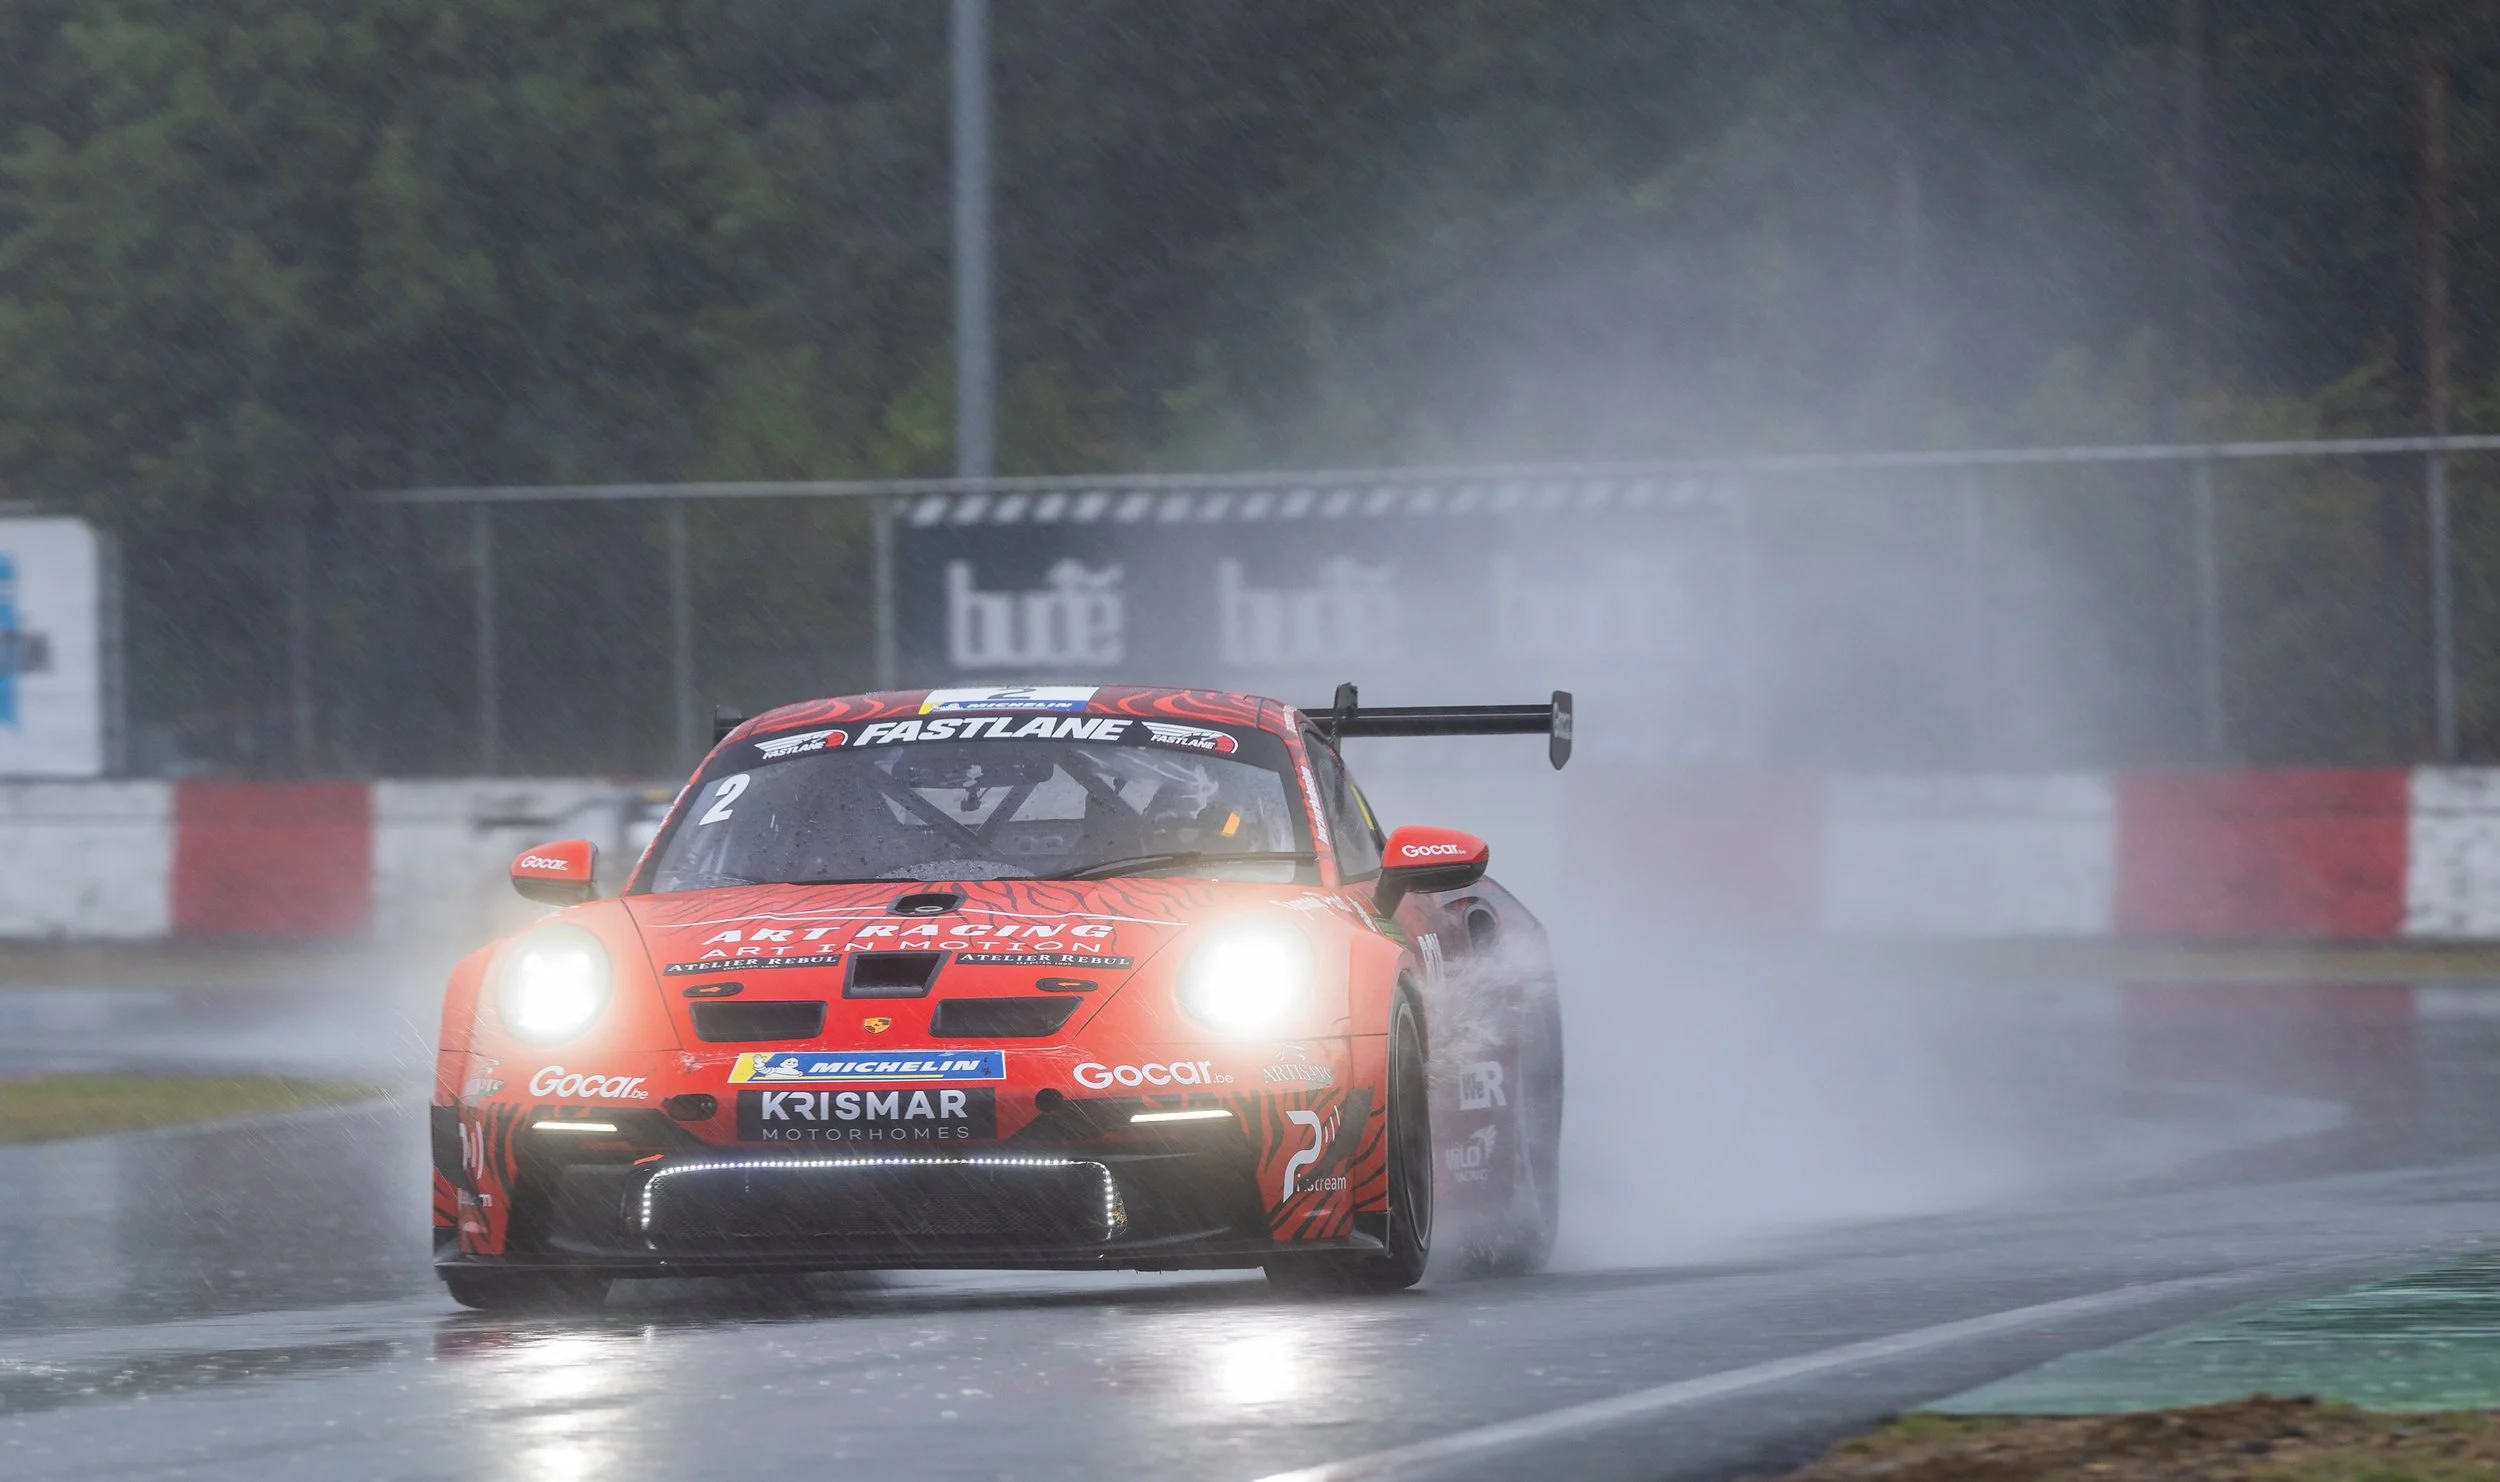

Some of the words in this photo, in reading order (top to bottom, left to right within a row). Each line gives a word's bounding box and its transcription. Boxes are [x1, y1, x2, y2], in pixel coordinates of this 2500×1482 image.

[987, 687, 1036, 700] 2
[967, 701, 1073, 710] MICHELIN
[853, 716, 1133, 747] FASTLANE
[762, 741, 827, 759] FASTLANE
[1151, 734, 1216, 750] FASTLANE
[698, 773, 751, 826] 2
[702, 926, 841, 945] ART
[855, 923, 1114, 939] RACING
[701, 946, 794, 960] ART
[816, 942, 874, 954] IN
[900, 940, 1102, 953] MOTION
[668, 958, 759, 972] ATELIER
[768, 956, 838, 965] REBUL
[960, 953, 1050, 962] ATELIER
[1061, 954, 1130, 965] REBUL
[808, 1060, 981, 1073] MICHELIN
[761, 1089, 968, 1121] KRISMAR
[762, 1126, 969, 1141] MOTORHOMES
